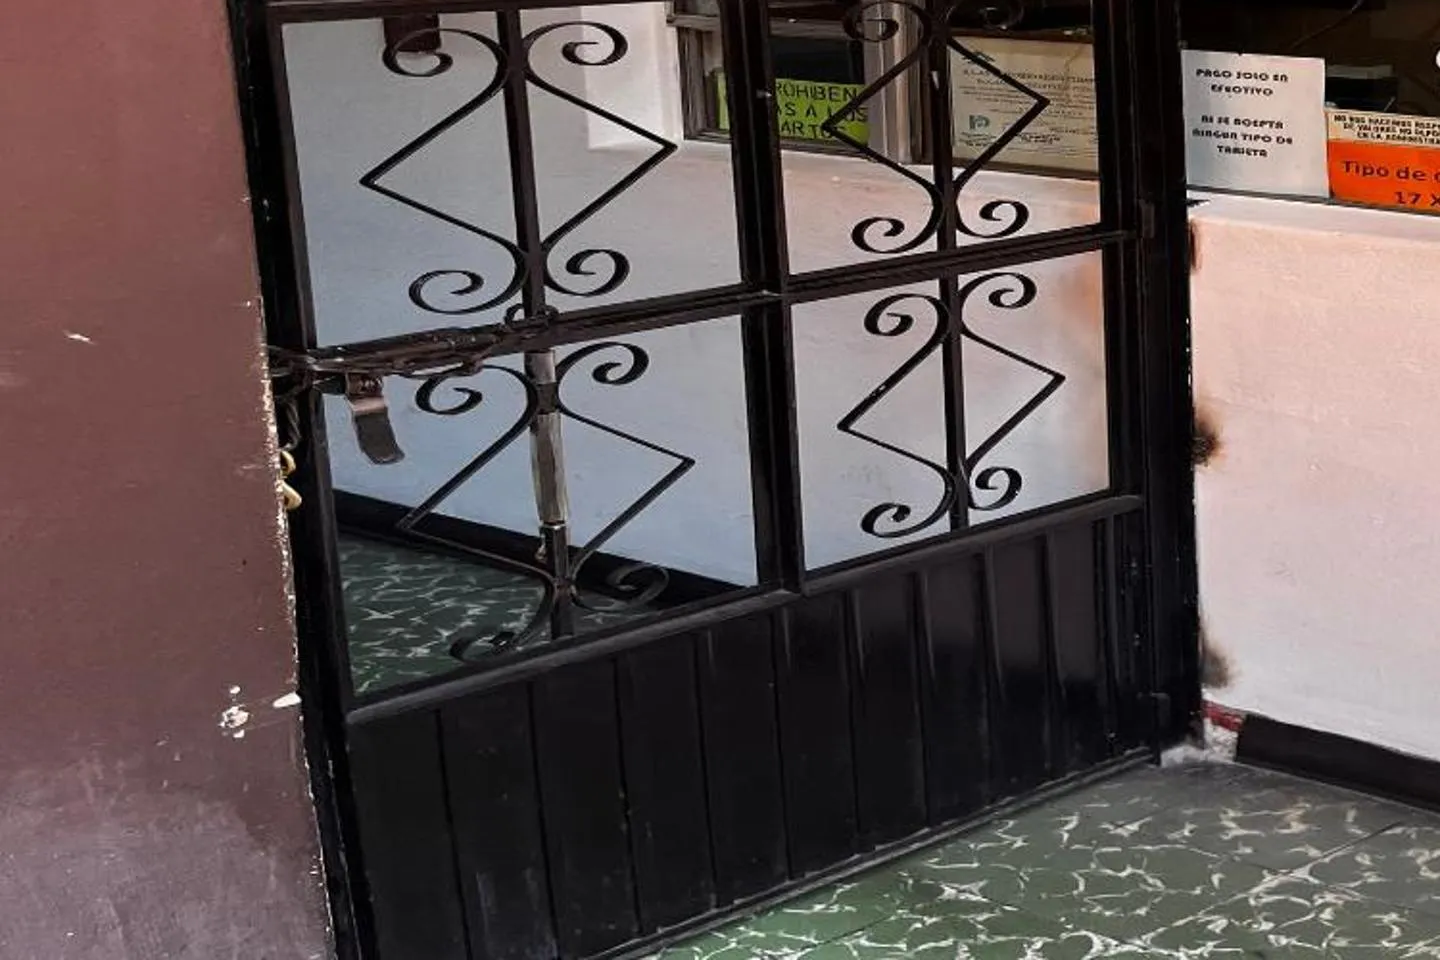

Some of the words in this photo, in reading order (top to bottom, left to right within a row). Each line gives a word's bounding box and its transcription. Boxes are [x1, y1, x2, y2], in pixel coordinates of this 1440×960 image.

[775, 80, 857, 103] ROHIBEN
[1342, 159, 1389, 178] Tipo
[1395, 166, 1426, 182] de
[1395, 191, 1421, 205] 17
